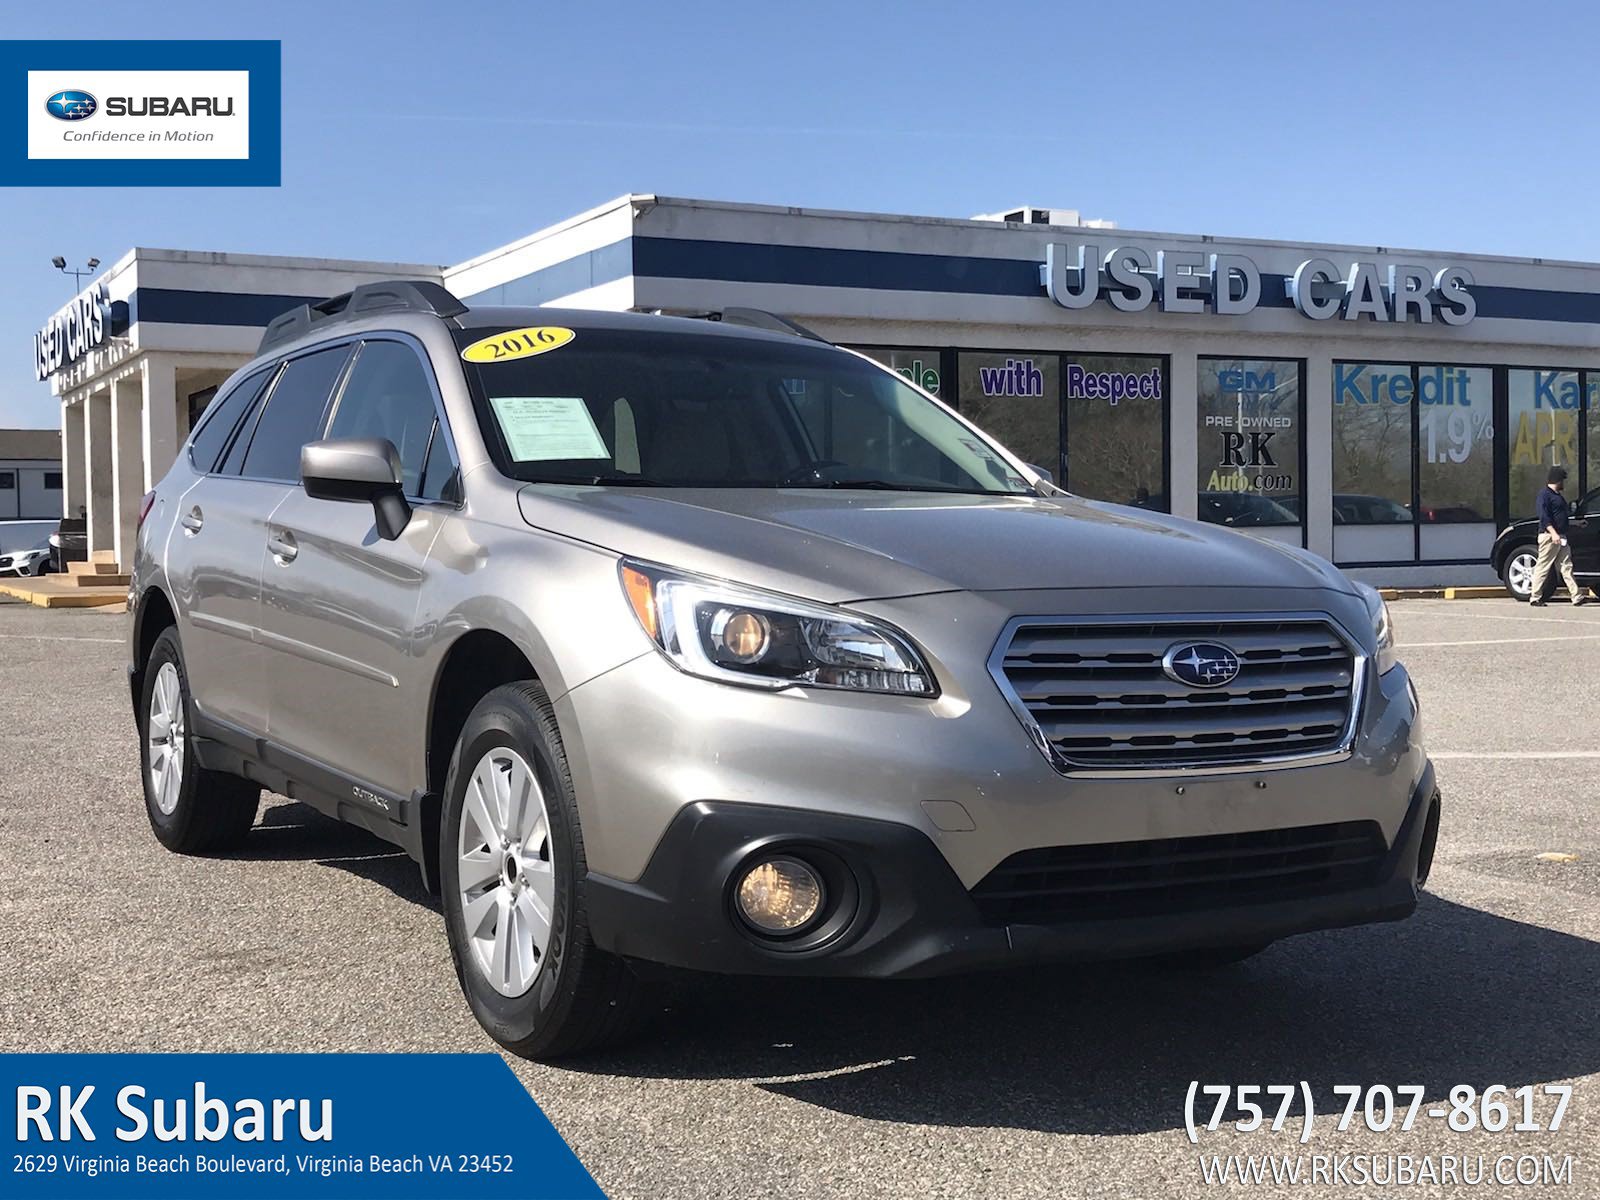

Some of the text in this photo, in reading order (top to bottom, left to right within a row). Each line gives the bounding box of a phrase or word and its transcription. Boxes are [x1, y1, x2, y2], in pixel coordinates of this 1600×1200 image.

[1045, 242, 1478, 327] USED CARS
[33, 282, 109, 382] USED CARS
[484, 329, 556, 359] 2016
[980, 359, 1043, 397] with
[1067, 363, 1162, 406] Respect
[1218, 370, 1277, 392] GM
[1334, 363, 1472, 407] Kredit
[1219, 431, 1278, 468] RK
[1513, 409, 1578, 465] APR
[1206, 469, 1292, 492] Auto.com
